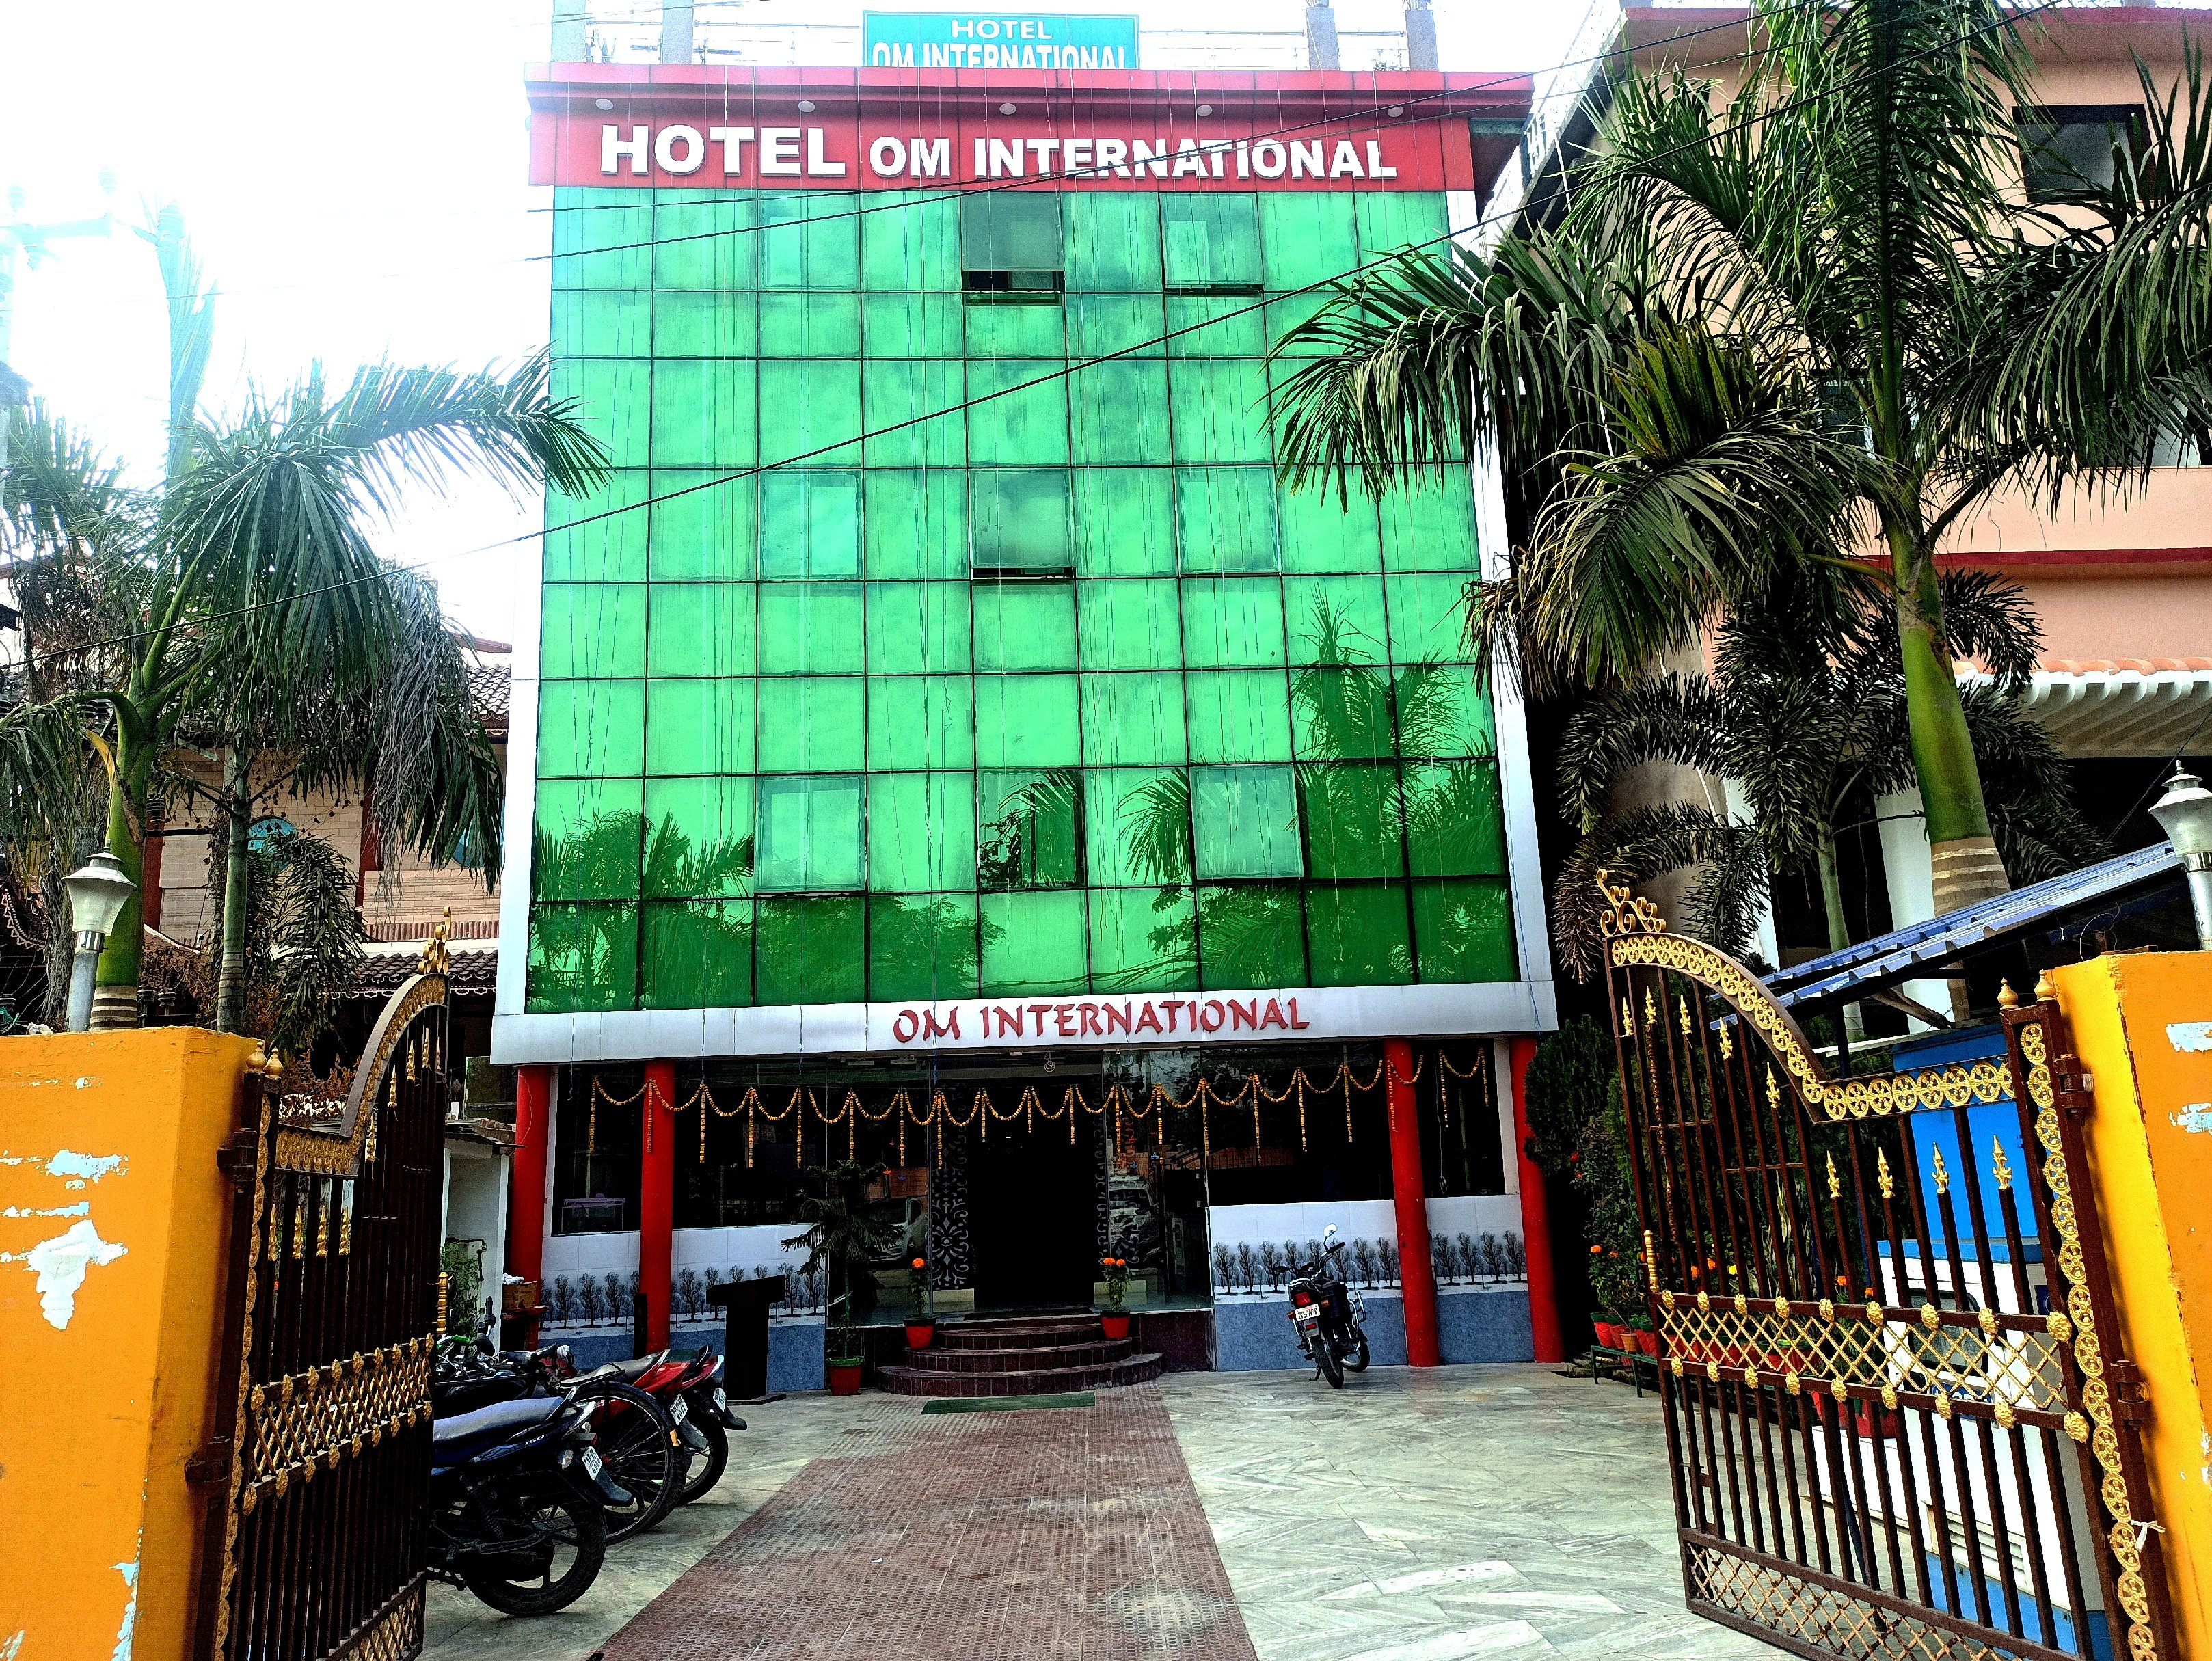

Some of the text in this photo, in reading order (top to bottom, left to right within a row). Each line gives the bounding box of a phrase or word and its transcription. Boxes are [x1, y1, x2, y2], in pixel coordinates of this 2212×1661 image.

[951, 19, 1053, 40] HOTEL
[872, 42, 915, 67] OM
[599, 124, 1397, 180] HOTEL OM INTERNATIONAL
[893, 997, 1310, 1044] OM INTERNATIONAL
